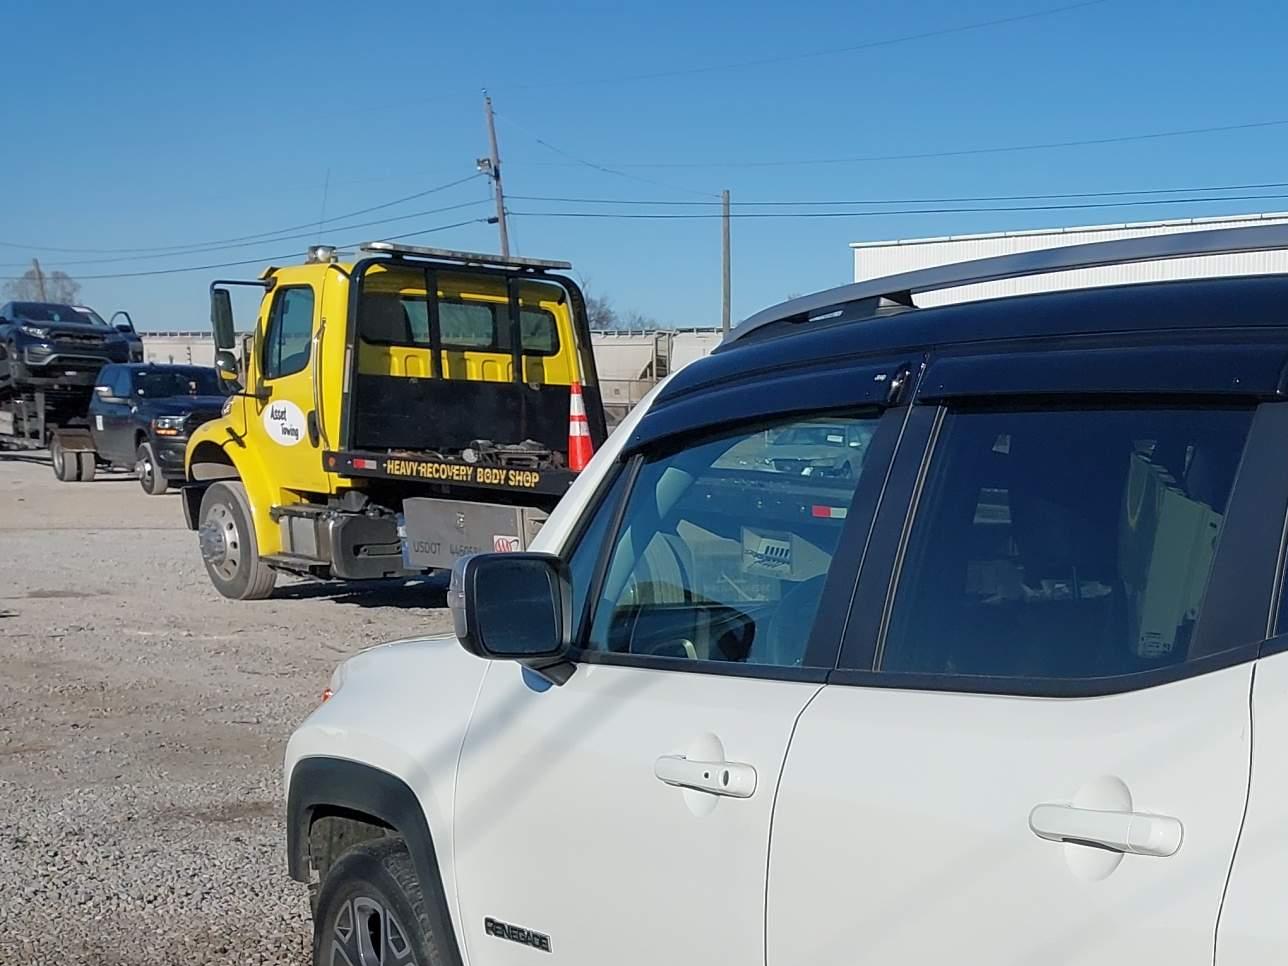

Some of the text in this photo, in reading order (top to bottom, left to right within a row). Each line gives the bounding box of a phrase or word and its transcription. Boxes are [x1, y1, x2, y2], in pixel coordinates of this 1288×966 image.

[270, 404, 287, 421] Asset
[280, 422, 299, 441] Towing
[476, 467, 507, 485] BODY
[508, 469, 540, 488] SHOP
[413, 542, 441, 555] USDOT
[483, 916, 552, 954] RENEGADE
